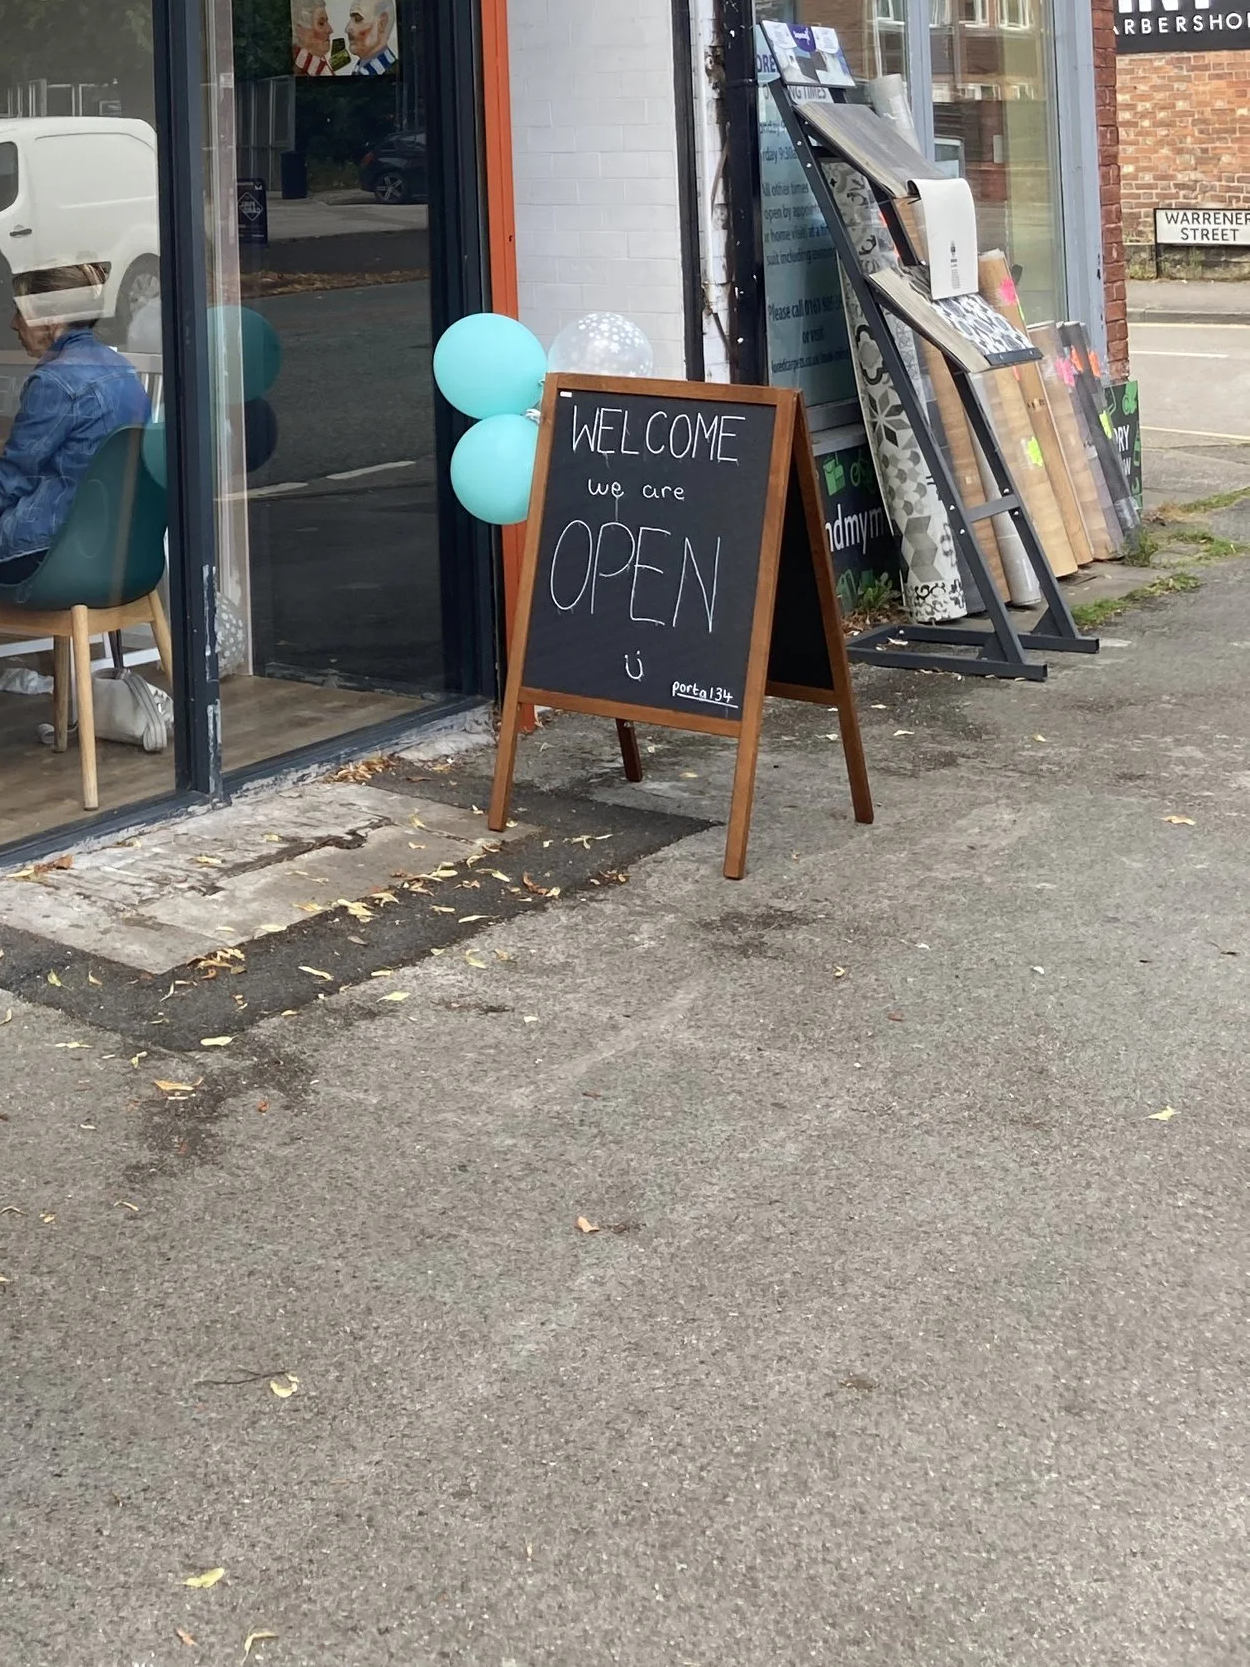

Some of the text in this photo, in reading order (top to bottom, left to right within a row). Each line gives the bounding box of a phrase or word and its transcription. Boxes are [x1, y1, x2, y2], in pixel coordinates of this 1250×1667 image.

[1113, 12, 1250, 36] RBERSHO
[1181, 227, 1239, 242] STREET
[571, 405, 746, 464] WELCOME
[588, 478, 685, 500] we are
[550, 519, 721, 633] OPEN
